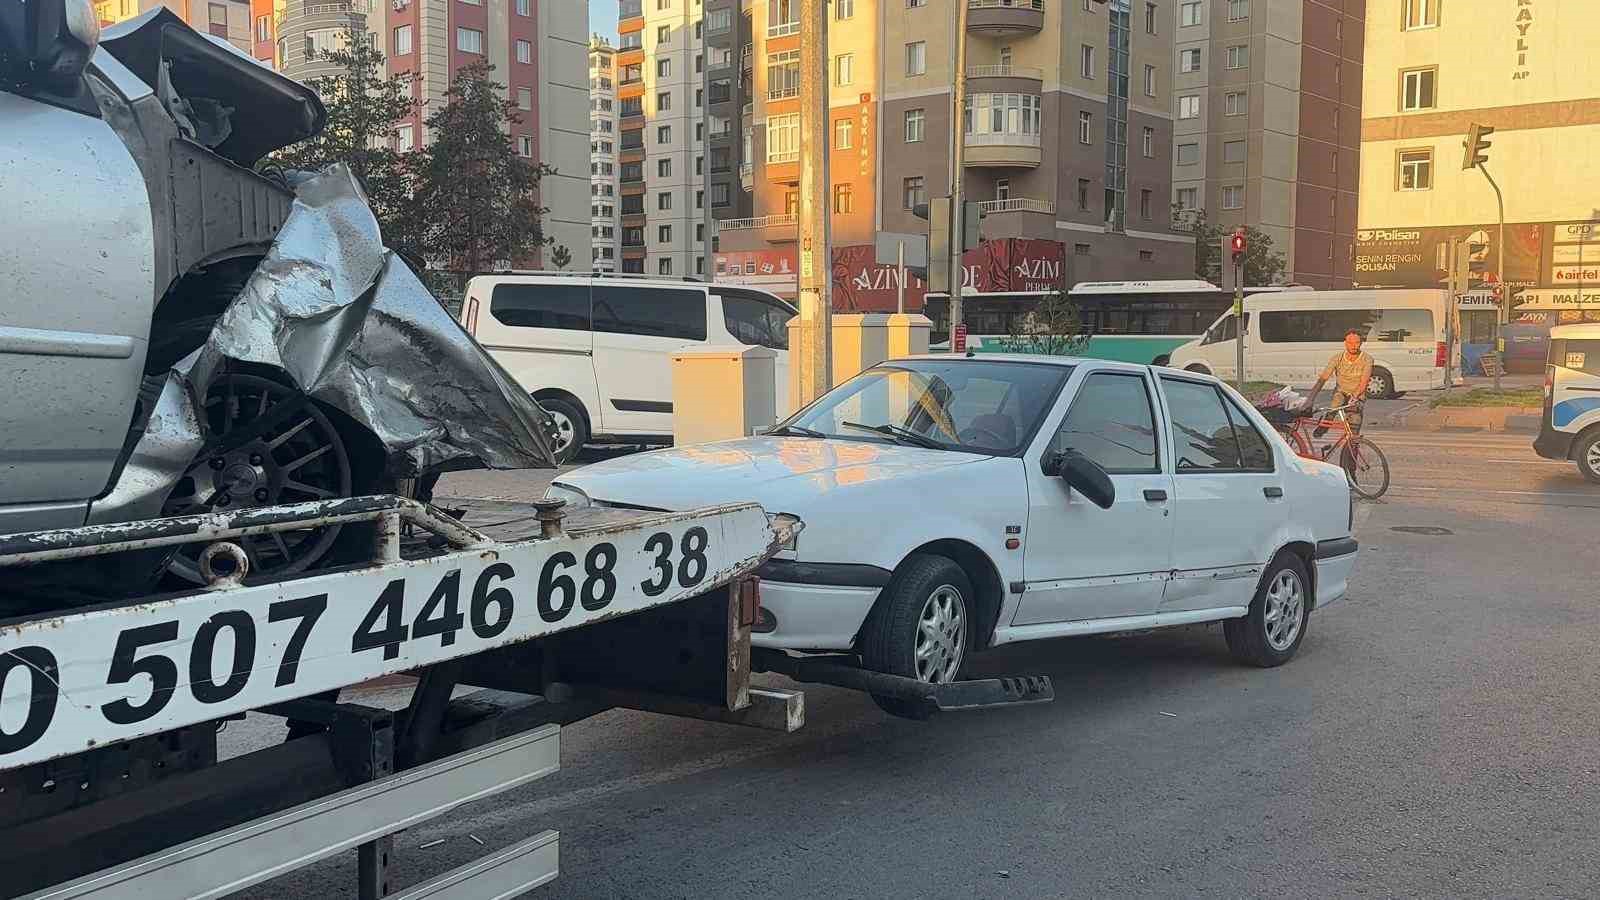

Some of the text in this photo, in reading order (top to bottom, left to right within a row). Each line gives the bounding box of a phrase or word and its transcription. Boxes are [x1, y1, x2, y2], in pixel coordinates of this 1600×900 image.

[1512, 71, 1530, 80] AP
[1375, 229, 1420, 241] Polisan
[1567, 225, 1592, 234] GPD
[1014, 255, 1060, 281] AZİM
[852, 264, 908, 290] AZİM
[1564, 270, 1598, 280] airfel
[1552, 294, 1600, 304] MALZE
[0, 526, 709, 755] 0 507 446 68 38
